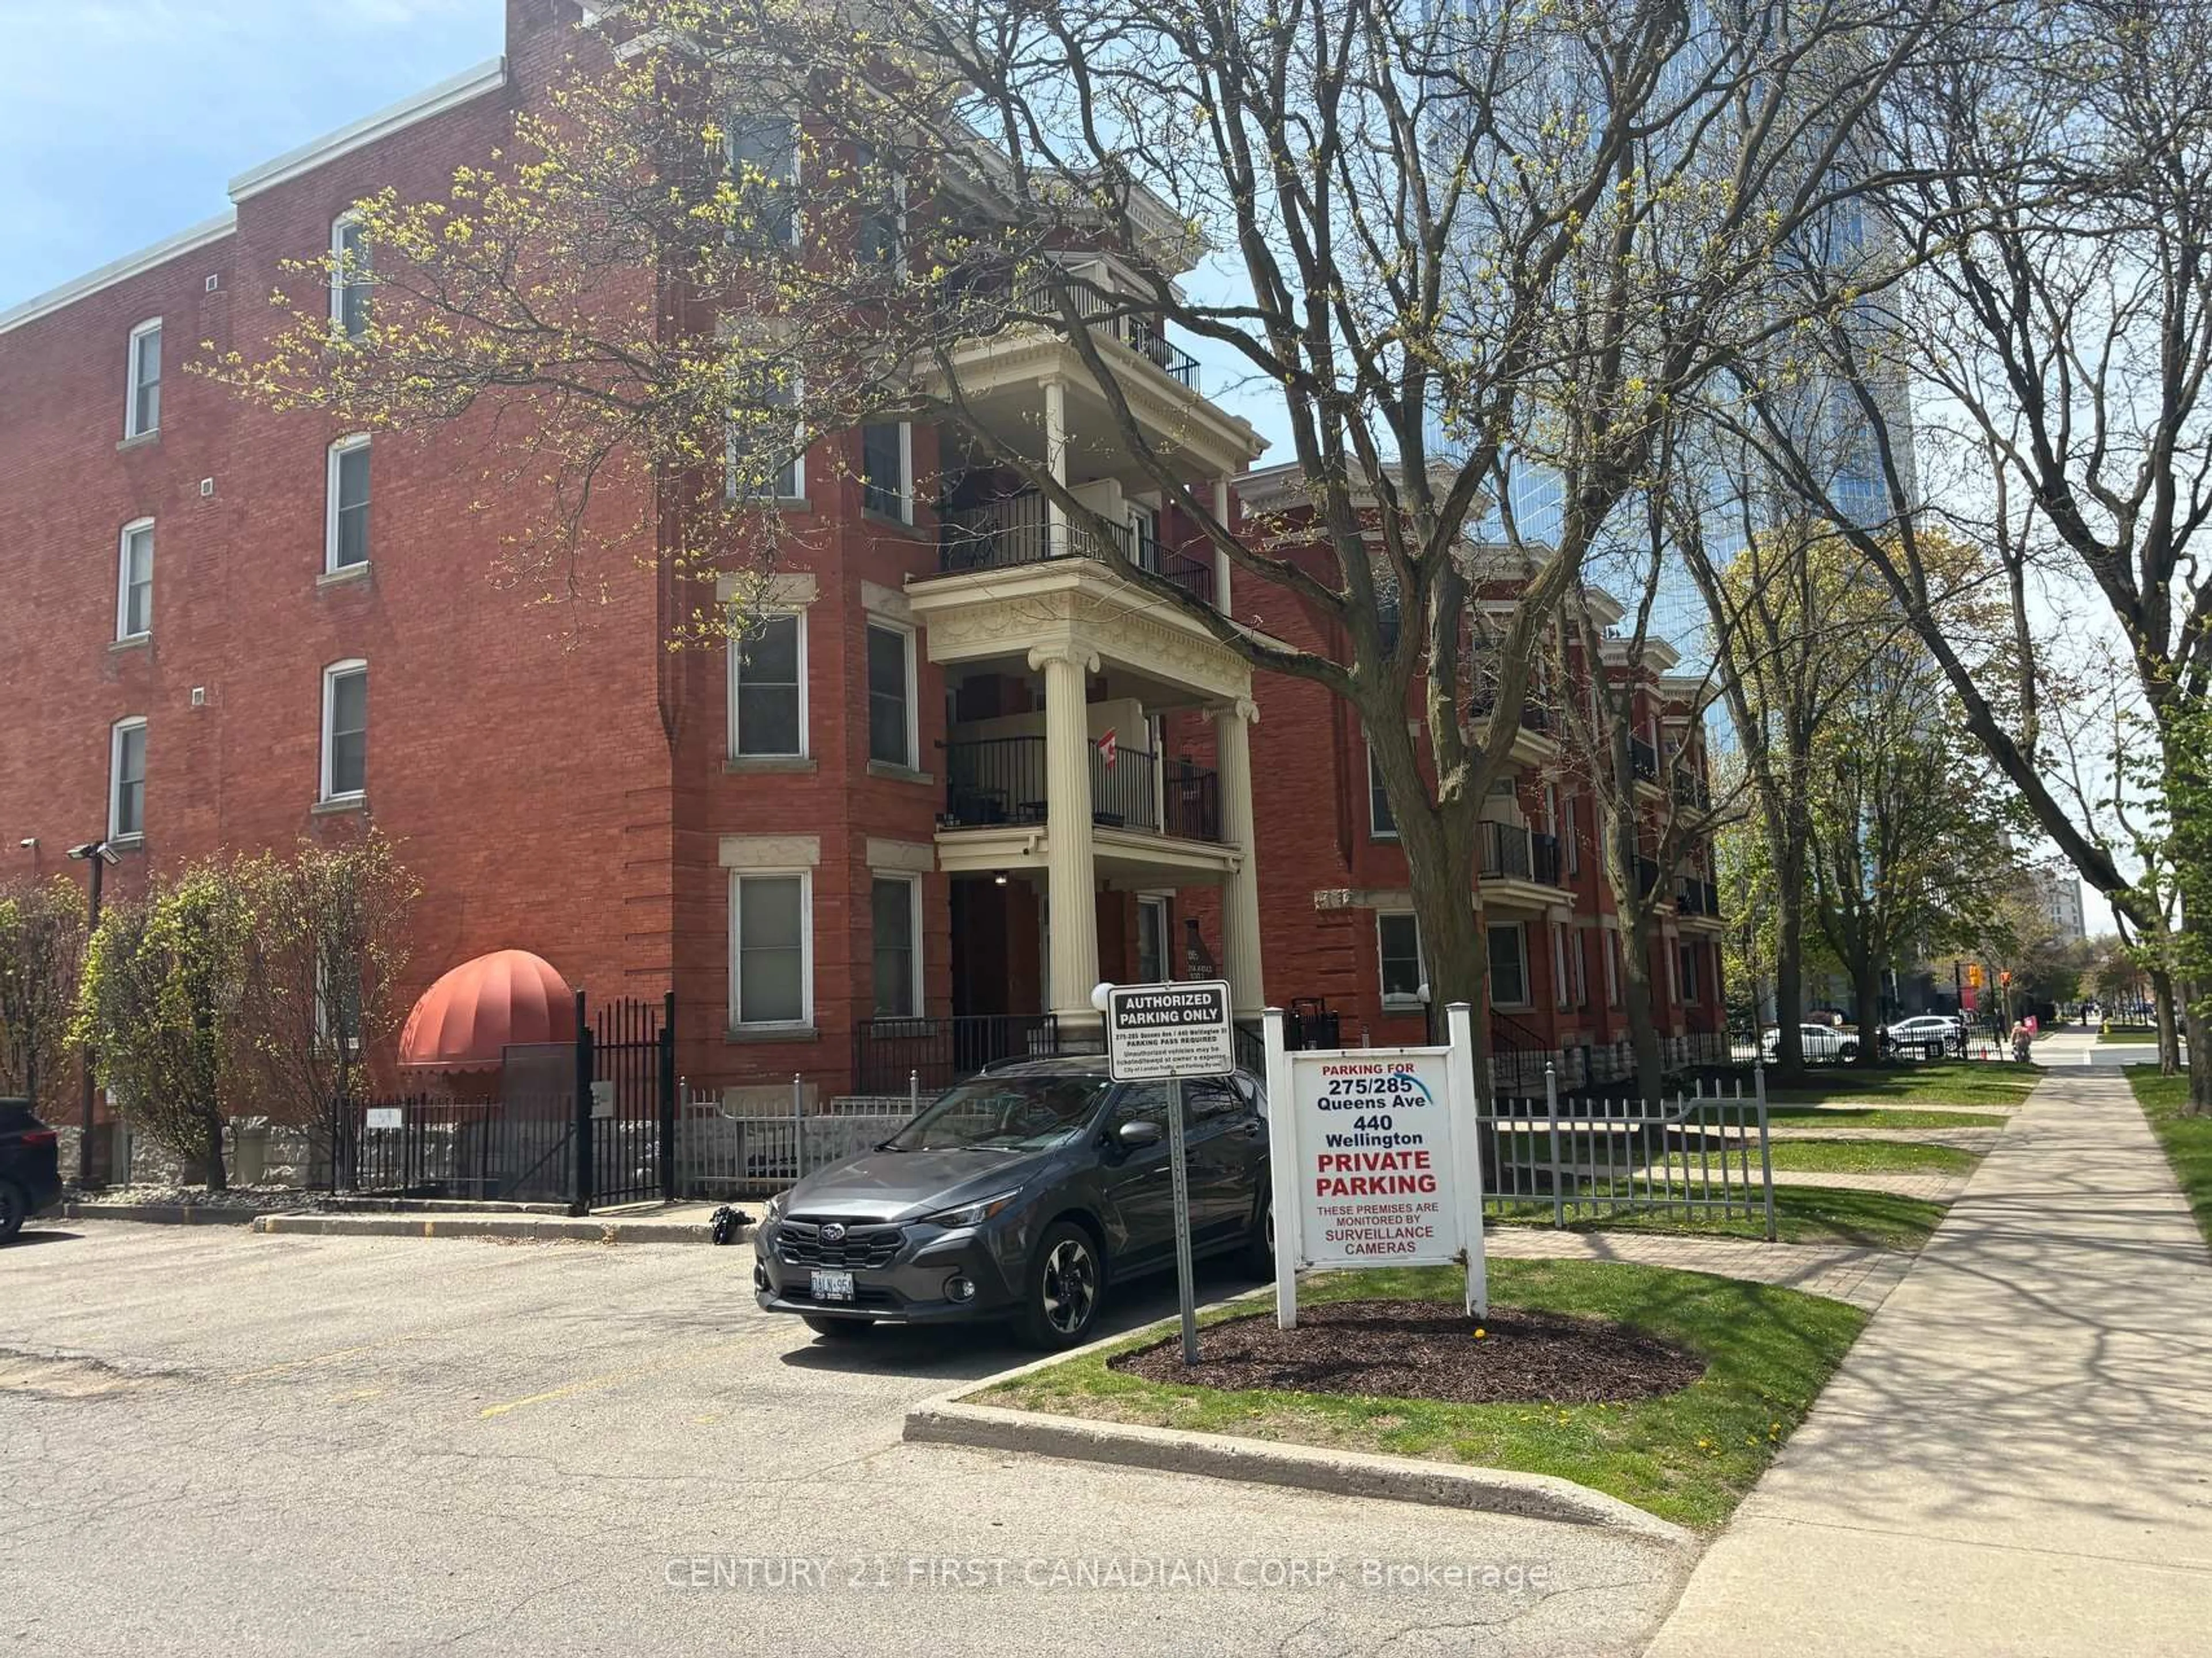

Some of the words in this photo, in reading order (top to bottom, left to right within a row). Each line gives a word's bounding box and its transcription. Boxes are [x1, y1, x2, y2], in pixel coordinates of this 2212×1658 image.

[1126, 993, 1211, 1009] AUTHORIZED
[1120, 1011, 1180, 1025] PARKING
[1183, 1008, 1218, 1022] ONLY
[1124, 1049, 1166, 1057] Unauthorized
[1322, 1064, 1382, 1076] PARKING
[1388, 1063, 1415, 1074] FOR
[1328, 1077, 1412, 1095] 275/285
[1317, 1097, 1386, 1111] Queens
[1392, 1094, 1426, 1108] Ave
[1354, 1115, 1392, 1130] 440
[1325, 1132, 1423, 1148] Wellington
[1317, 1150, 1431, 1173] PRIVATE
[1316, 1174, 1437, 1197] PARKING
[1317, 1206, 1354, 1216] THESE
[1357, 1204, 1412, 1215] PREMISES
[1416, 1202, 1439, 1212] ARE
[1336, 1215, 1403, 1226] MONITORED
[1406, 1214, 1421, 1224] BY
[1325, 1226, 1434, 1242] SURVEILLANCE
[1345, 1241, 1416, 1255] CAMERAS
